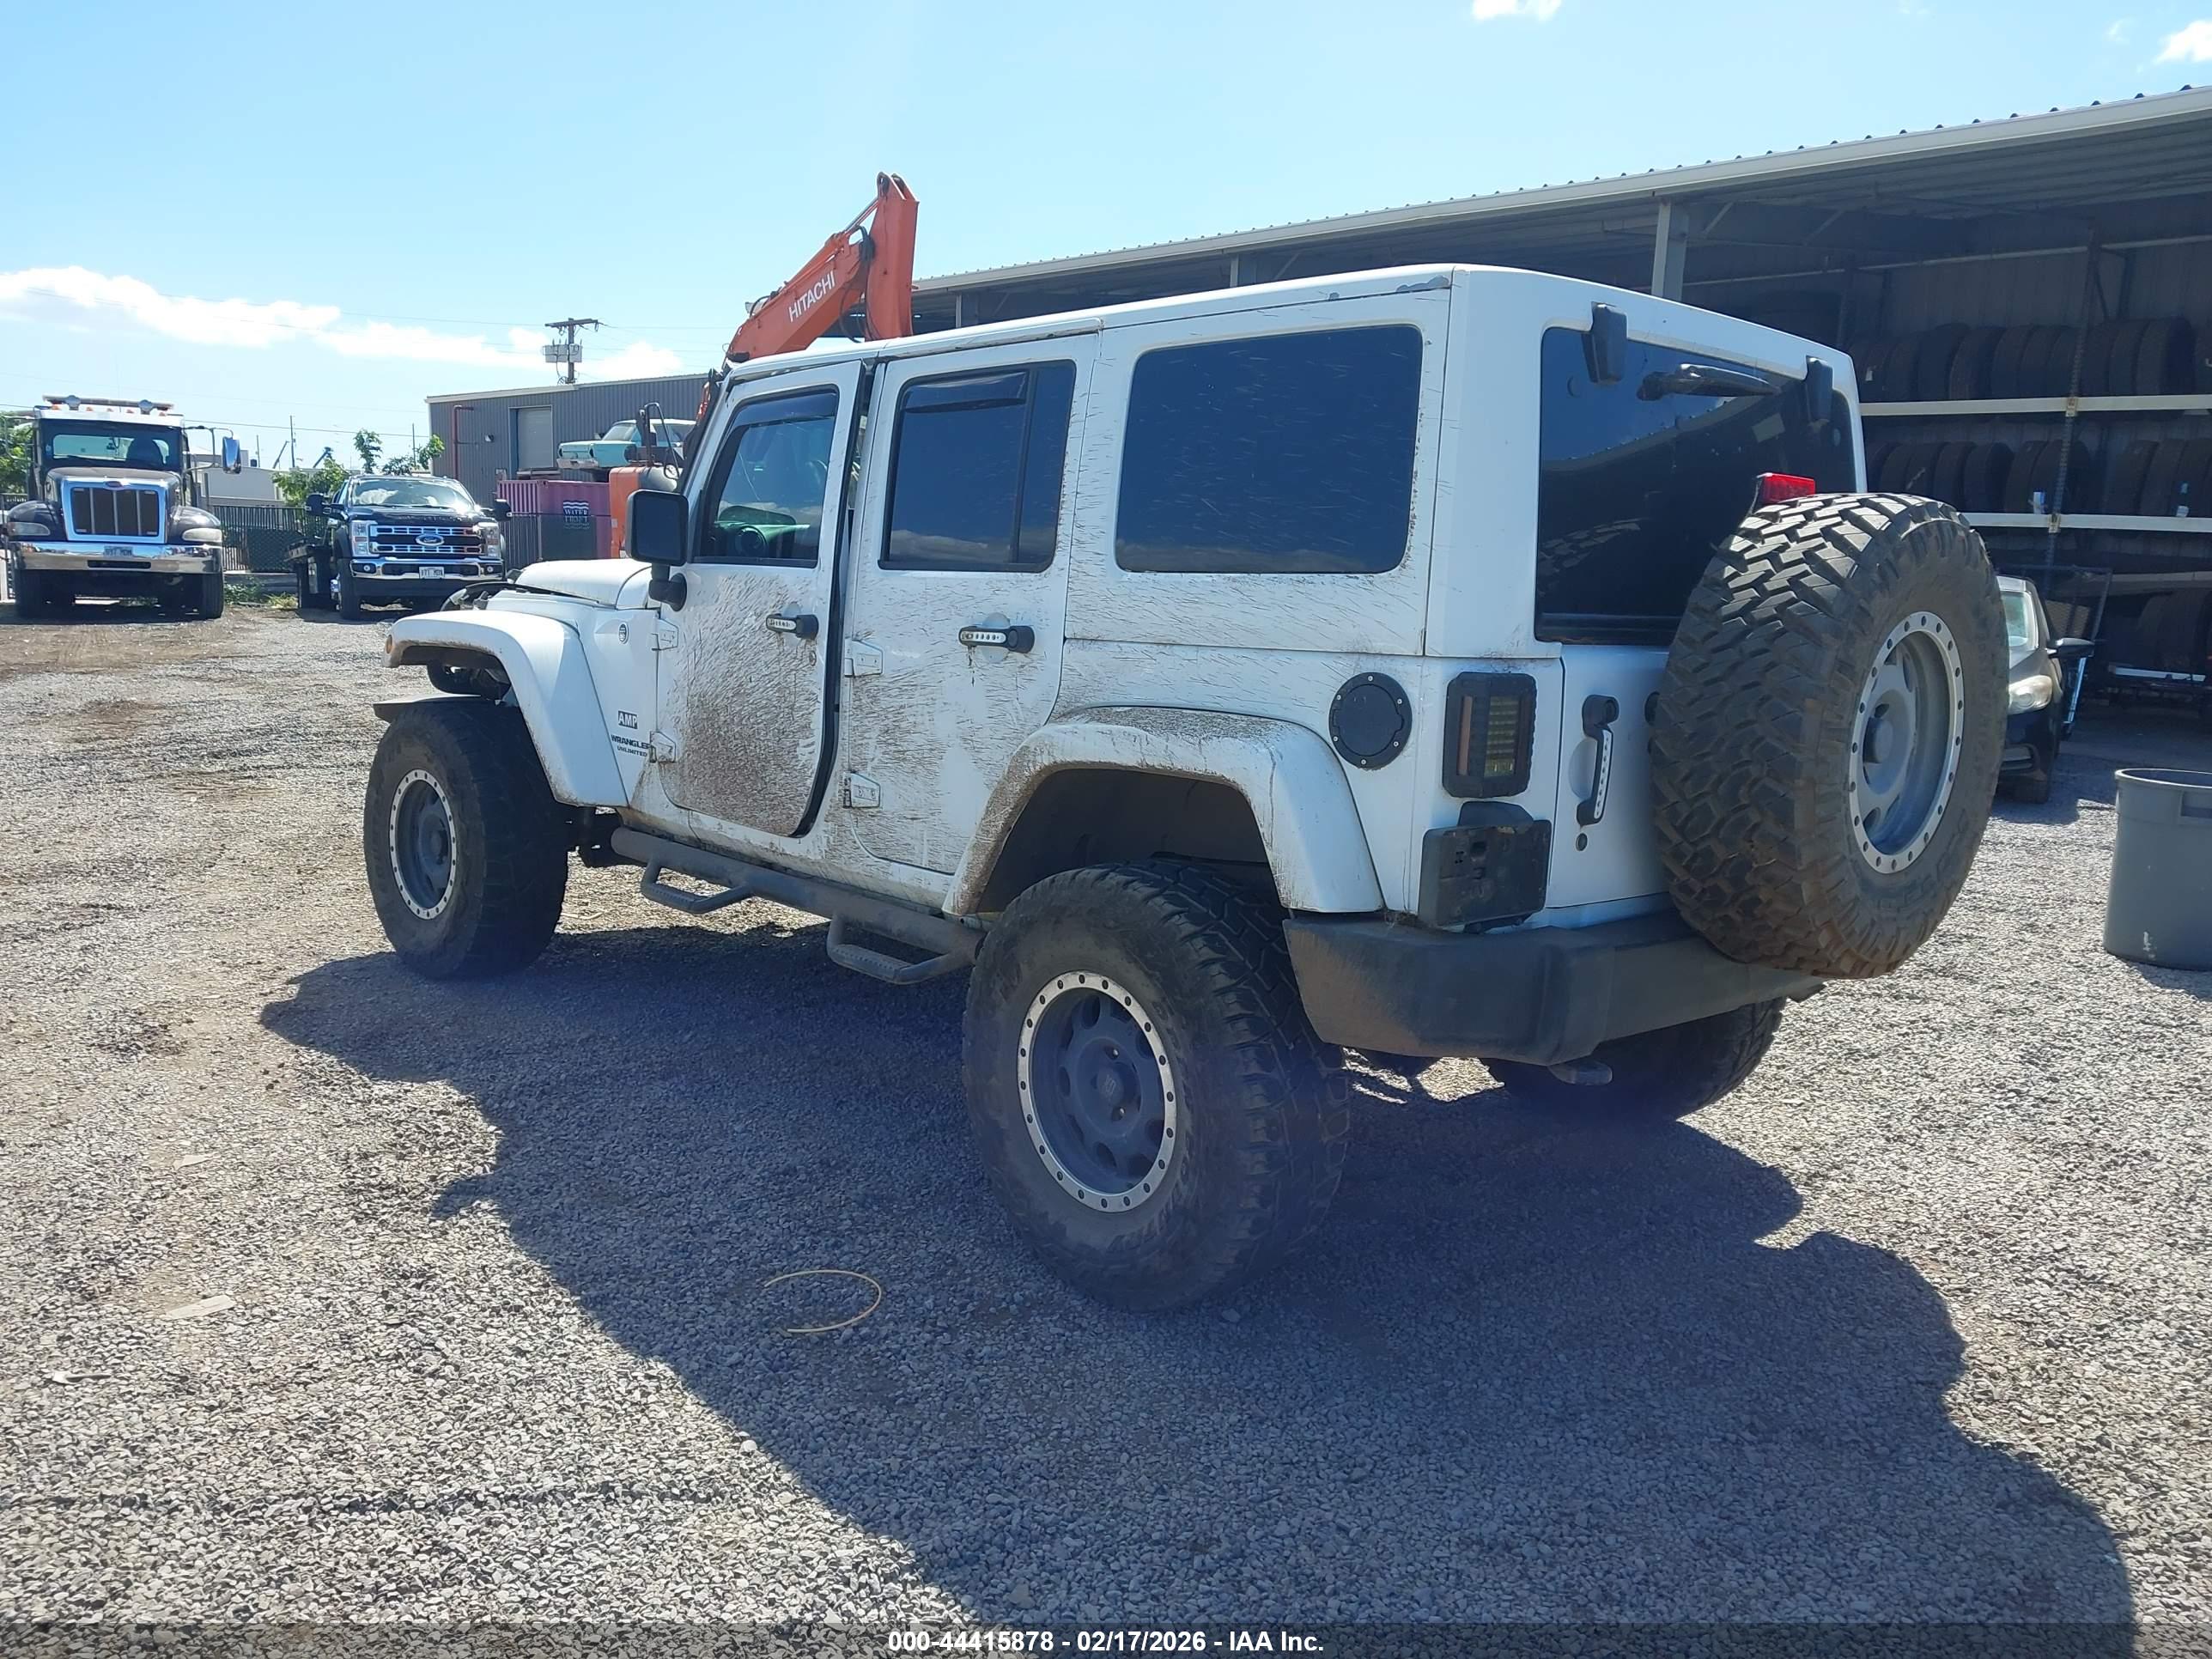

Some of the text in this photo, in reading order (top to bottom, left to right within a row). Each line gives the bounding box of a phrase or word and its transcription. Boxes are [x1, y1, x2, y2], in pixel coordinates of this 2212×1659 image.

[788, 270, 836, 323] HITACHI
[618, 712, 637, 728] AMP
[617, 745, 647, 757] UNLIMITED
